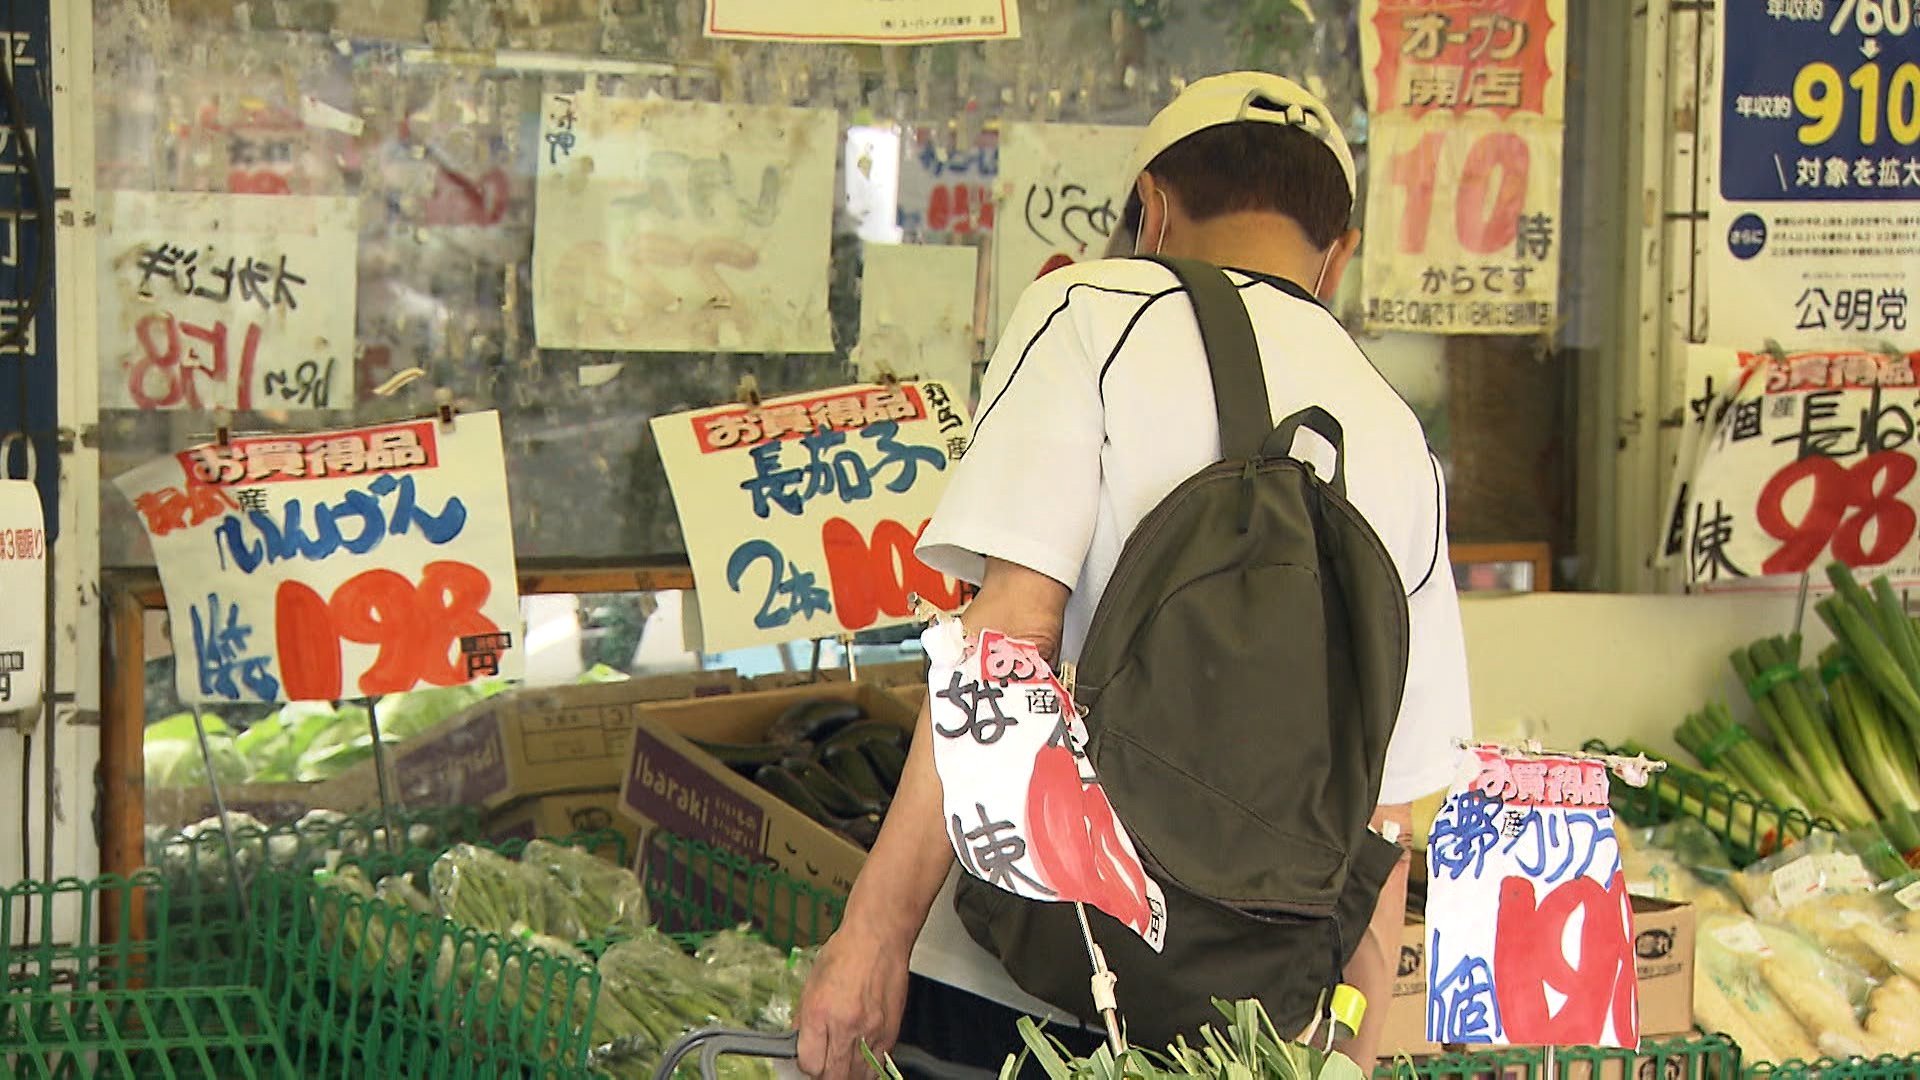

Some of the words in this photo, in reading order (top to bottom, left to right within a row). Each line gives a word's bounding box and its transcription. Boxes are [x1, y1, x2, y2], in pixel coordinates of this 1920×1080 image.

[1402, 13, 1528, 62] オープン
[1401, 65, 1523, 108] 開店
[1389, 133, 1529, 255] 10
[1421, 265, 1535, 295] からです
[1794, 286, 1908, 332] 公明党
[706, 388, 920, 449] お買得品
[192, 428, 428, 484] お買得品
[740, 420, 946, 518] 長茄子
[1757, 449, 1918, 576] 98
[275, 560, 502, 701] 198
[1025, 688, 1060, 714] 産
[634, 751, 710, 827] Ibaraki
